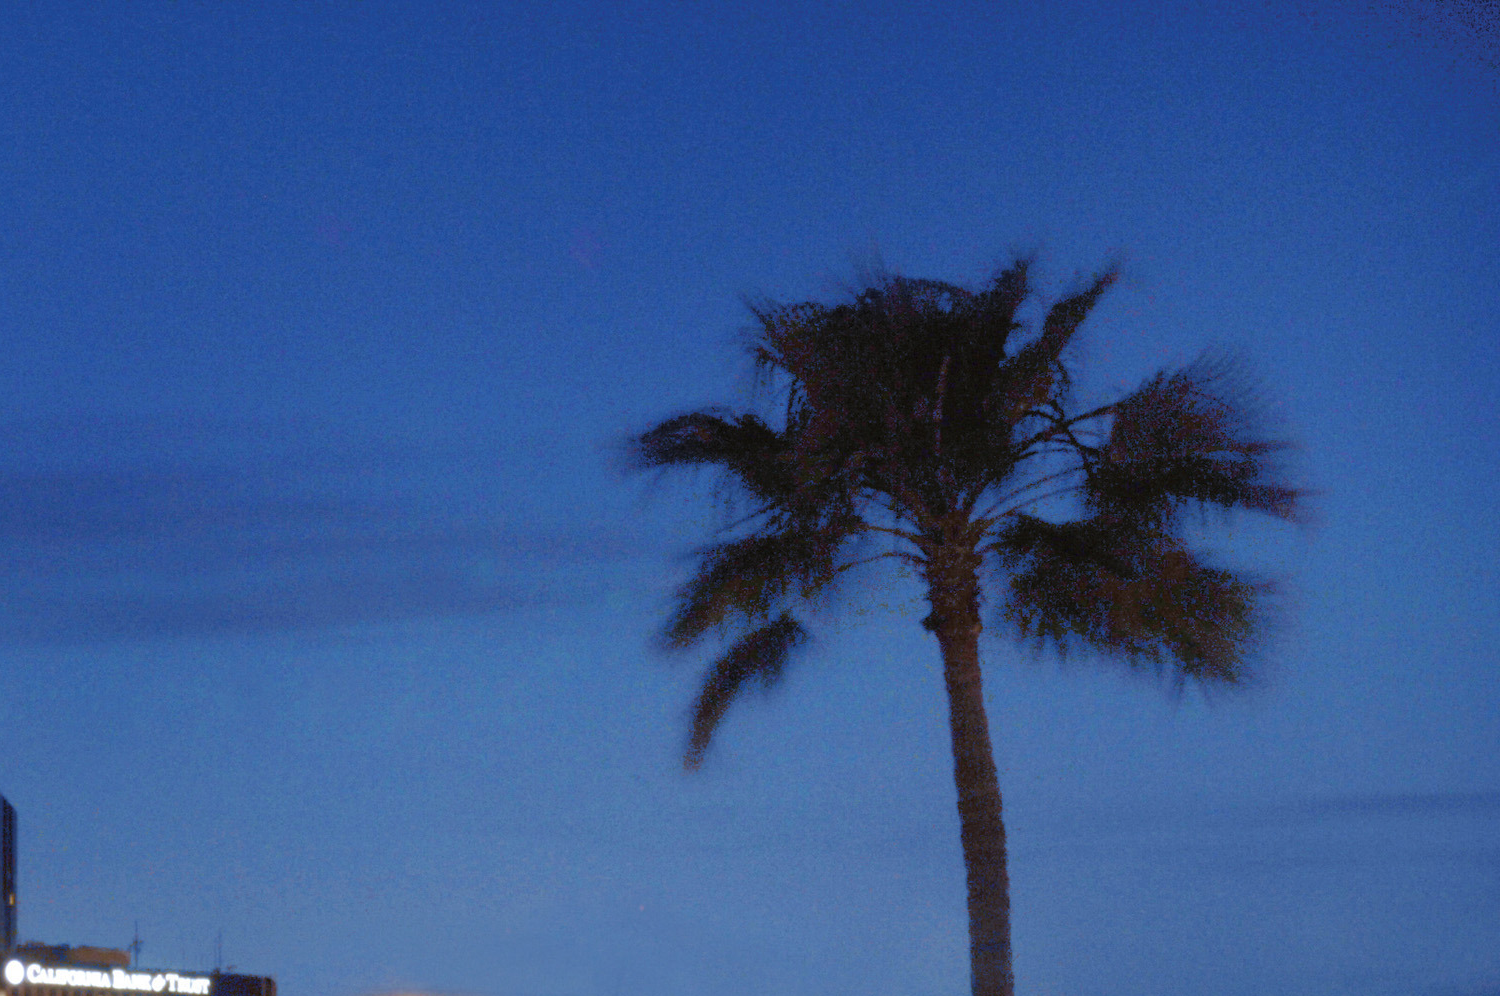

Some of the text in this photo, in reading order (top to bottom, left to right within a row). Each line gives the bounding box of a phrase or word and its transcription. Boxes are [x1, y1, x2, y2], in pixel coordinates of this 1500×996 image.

[26, 963, 210, 994] CALIFORNIA BANK & TRUST
